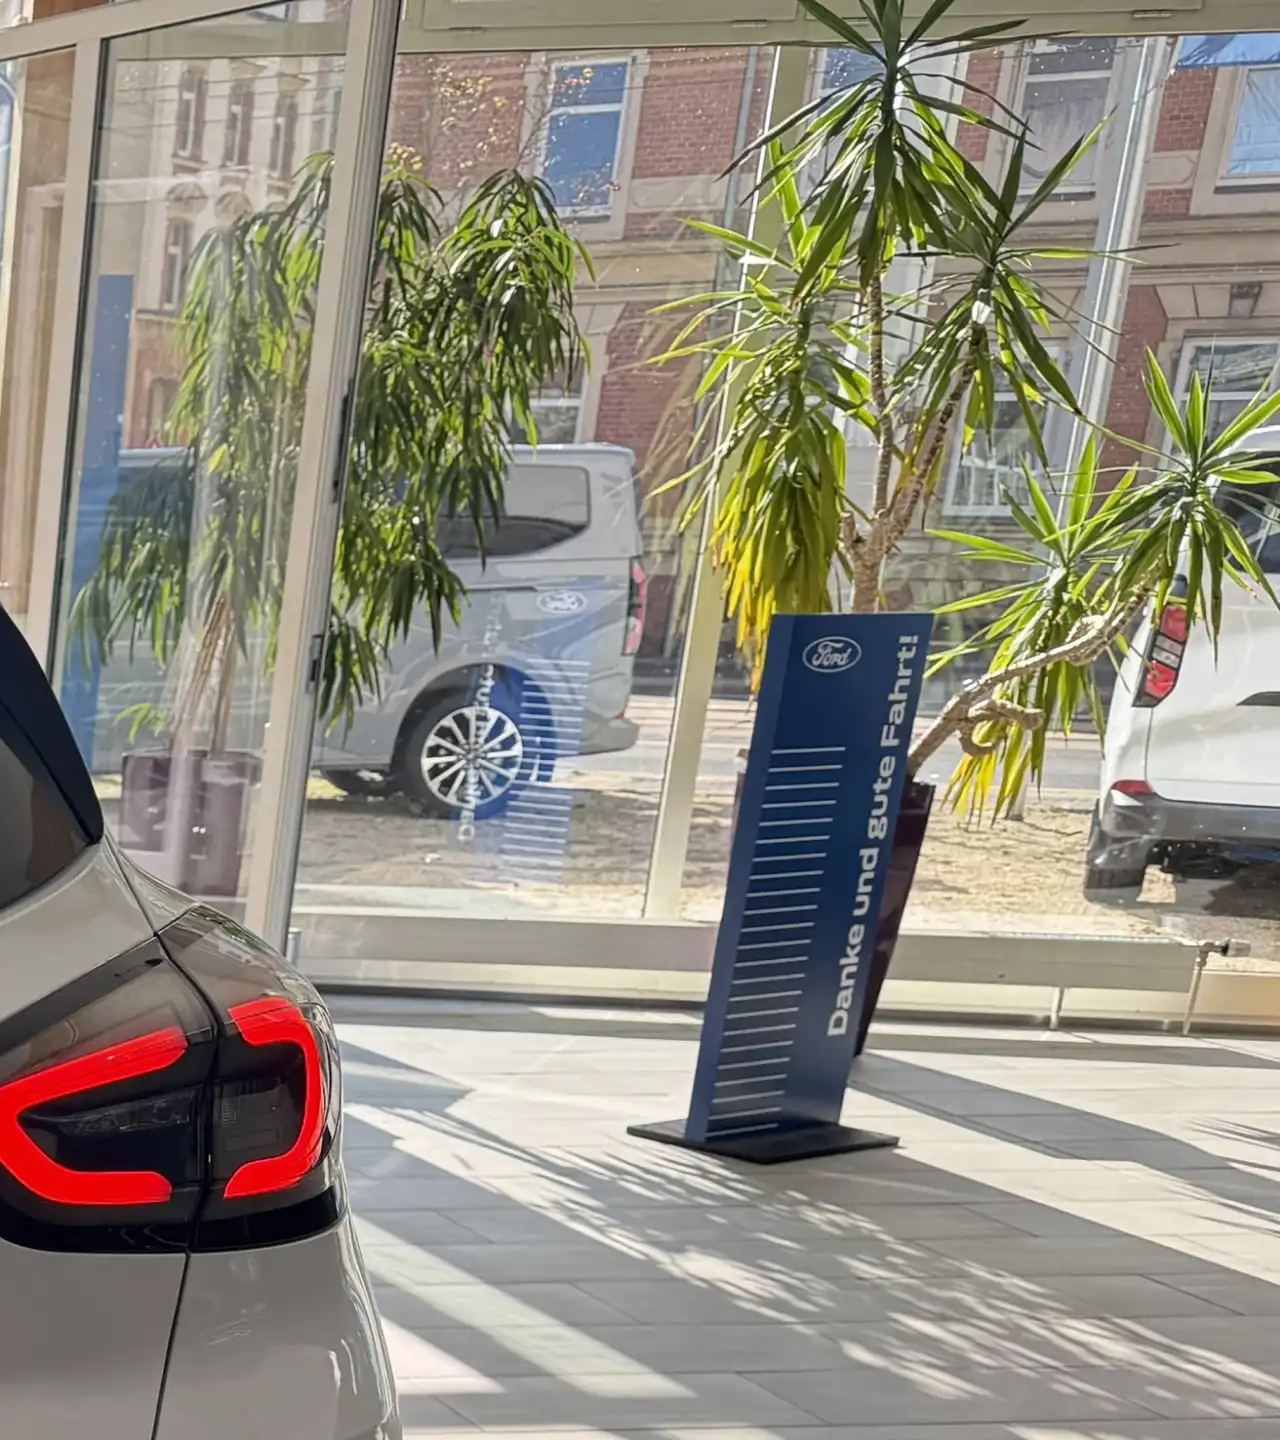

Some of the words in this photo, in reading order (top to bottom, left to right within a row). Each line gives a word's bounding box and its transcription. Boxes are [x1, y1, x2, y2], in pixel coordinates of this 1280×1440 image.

[880, 633, 920, 754] Fahrt!
[867, 764, 899, 841] gute
[852, 846, 879, 917] und
[828, 924, 864, 1037] Danke
